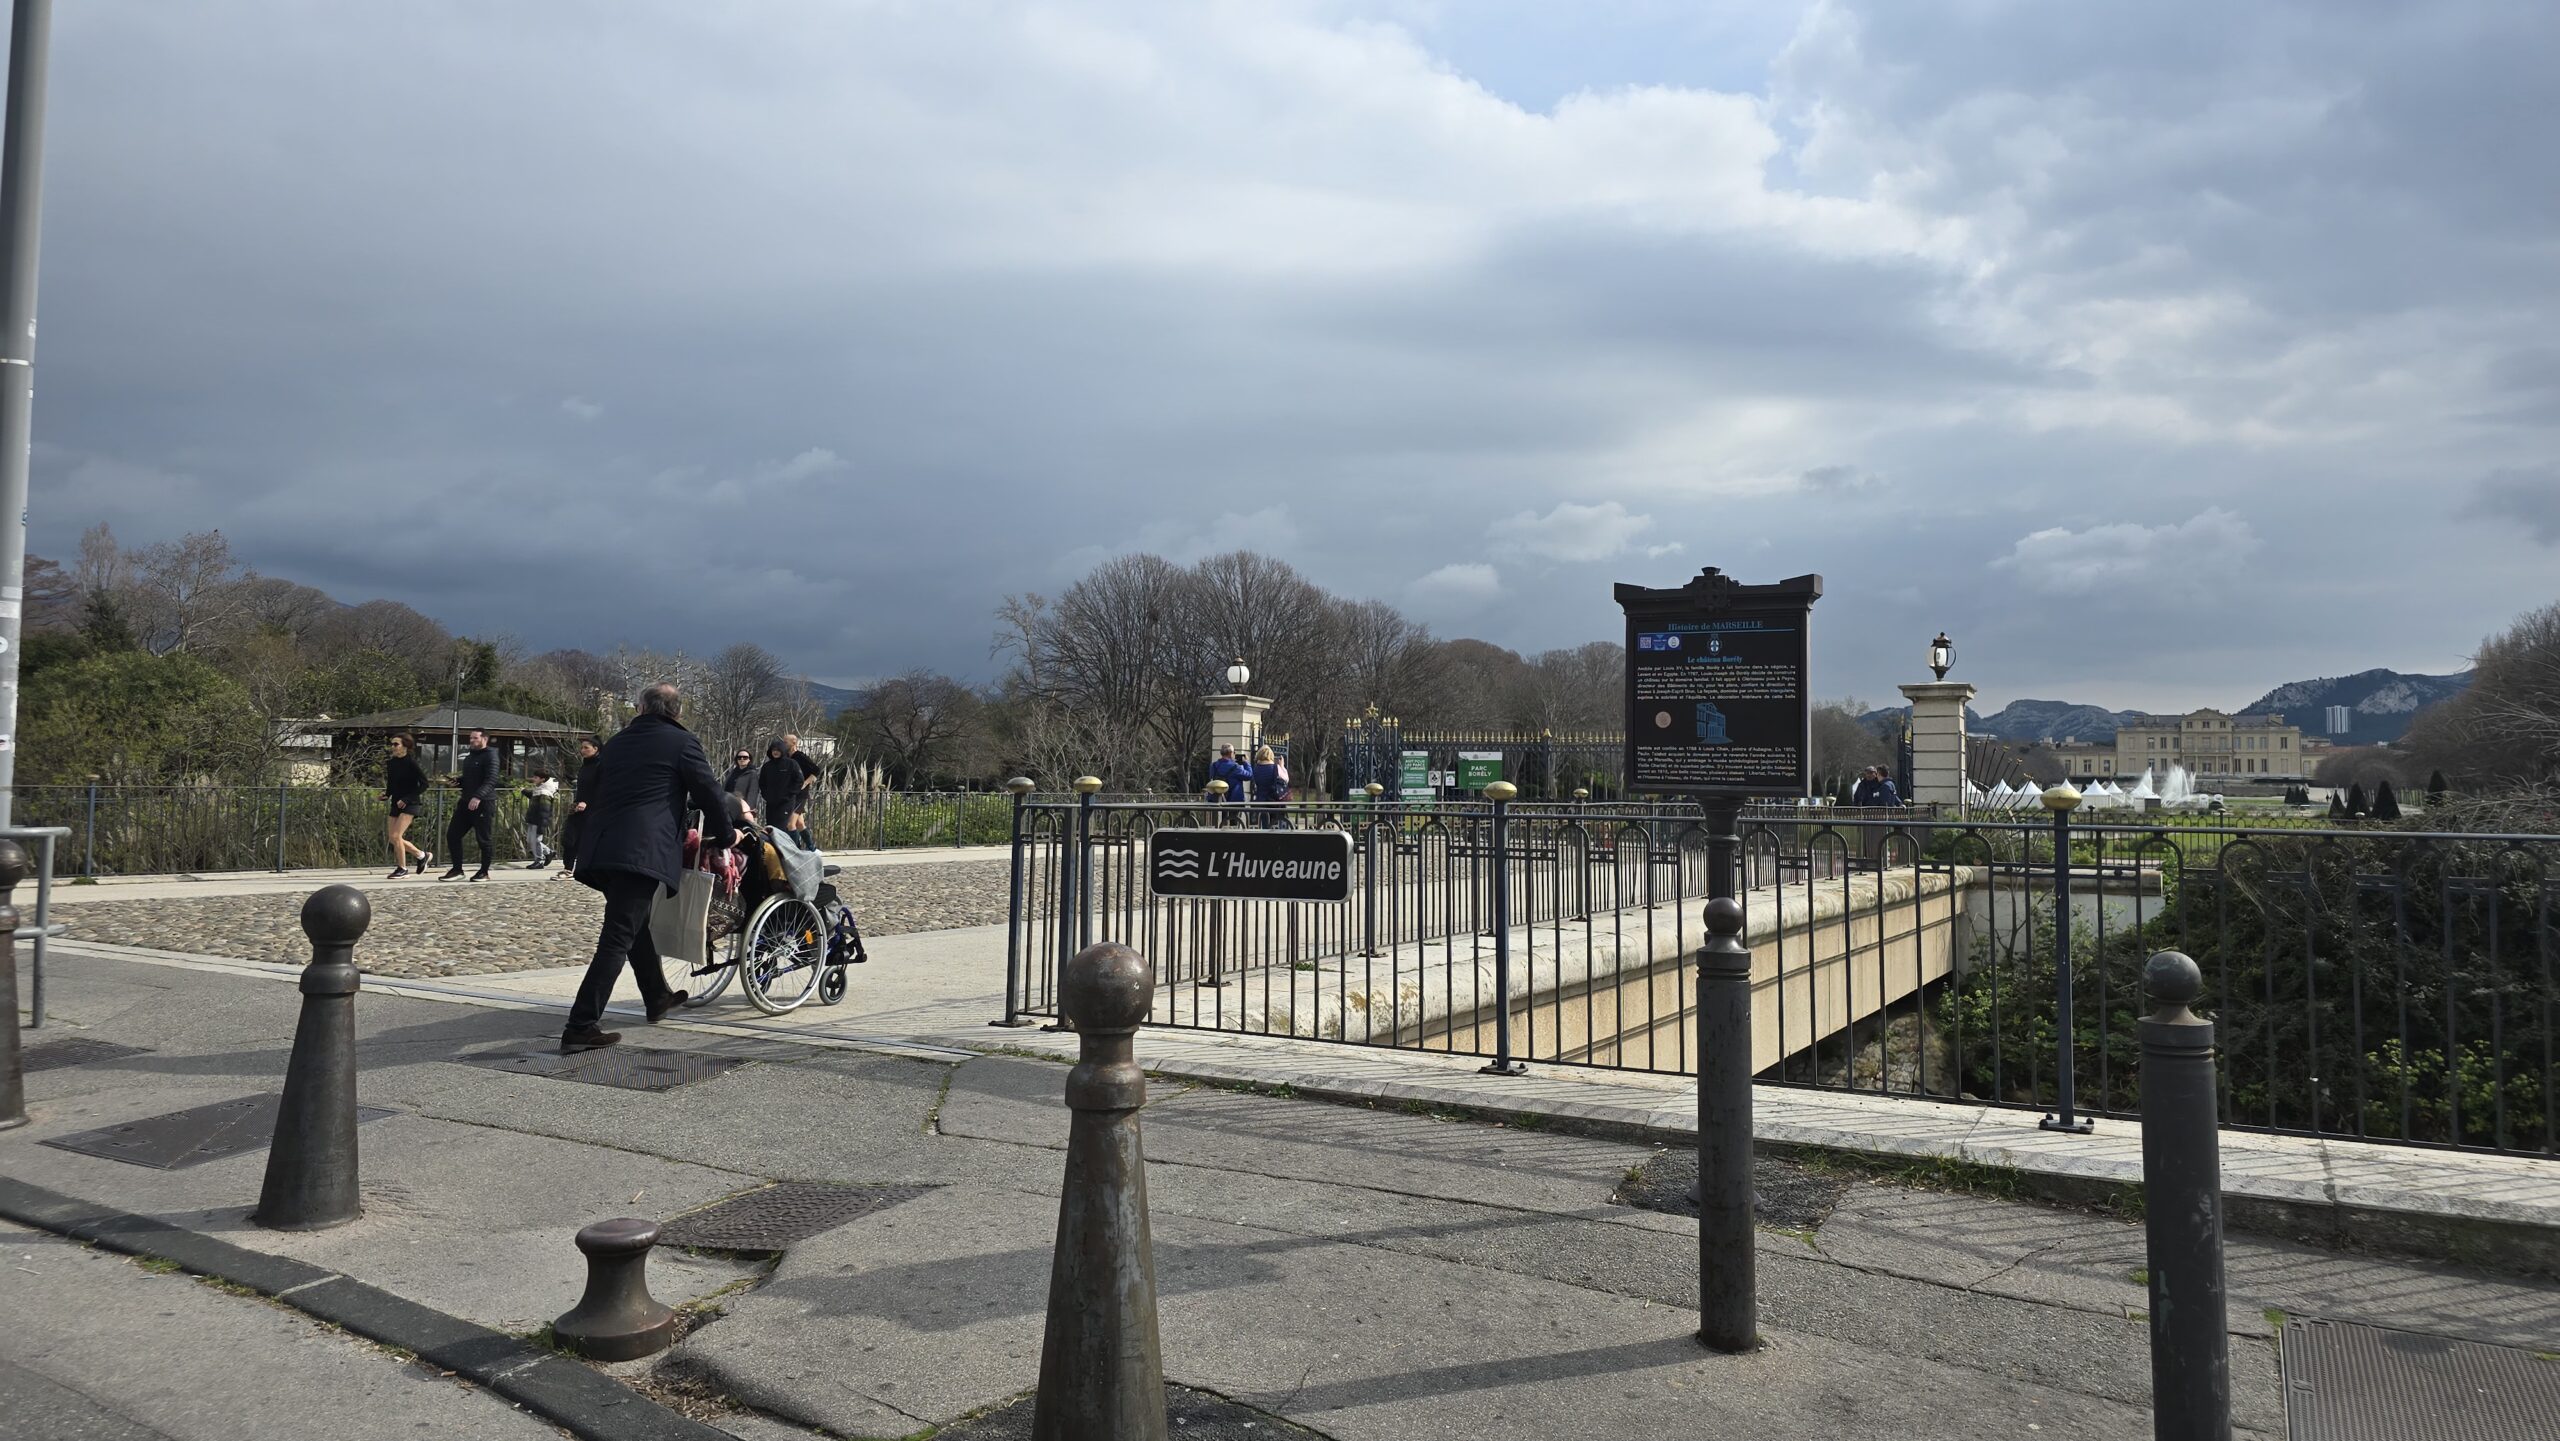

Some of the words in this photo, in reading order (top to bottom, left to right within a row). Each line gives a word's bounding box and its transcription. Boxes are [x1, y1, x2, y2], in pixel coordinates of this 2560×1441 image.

[1668, 623, 1700, 631] Histoire
[1701, 622, 1711, 630] de
[1712, 621, 1763, 630] MARSEILLE
[1207, 851, 1341, 880] L'Huveaune
